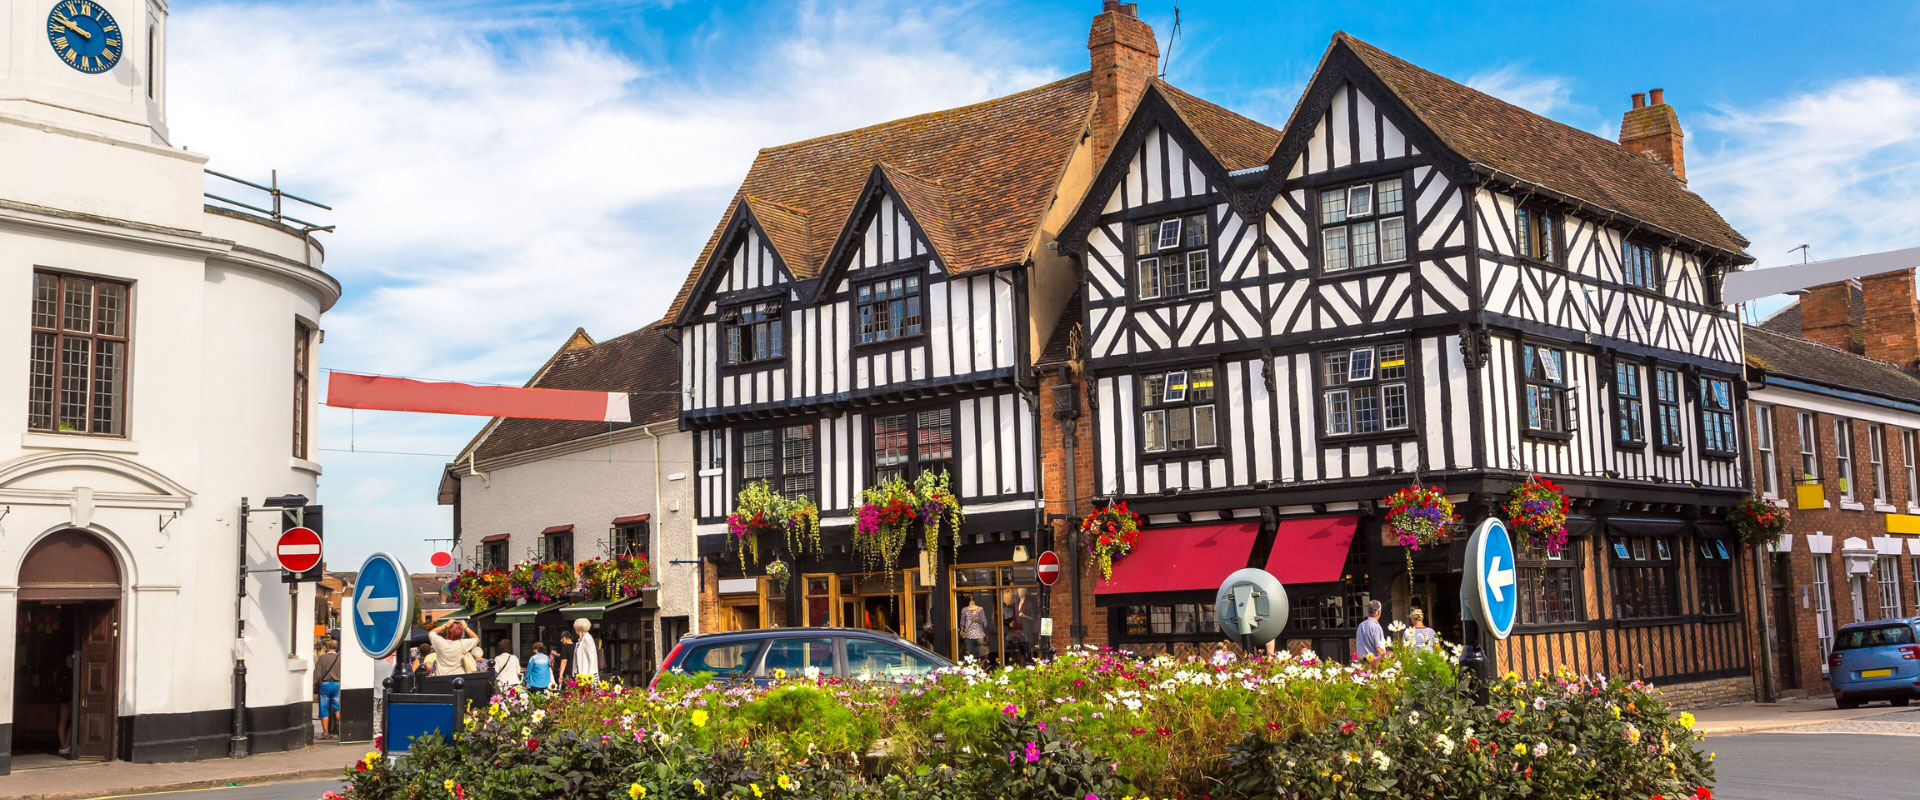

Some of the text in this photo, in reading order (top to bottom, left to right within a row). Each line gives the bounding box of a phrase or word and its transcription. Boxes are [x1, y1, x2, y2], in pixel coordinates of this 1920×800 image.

[67, 4, 78, 16] XI
[81, 4, 91, 17] XII
[96, 11, 104, 21] I
[53, 24, 65, 34] IX
[103, 25, 115, 33] II
[55, 36, 69, 50] VIII
[106, 38, 118, 47] III
[66, 48, 78, 61] VII
[102, 48, 116, 61] IIII
[81, 56, 90, 69] VI
[95, 56, 104, 67] V
